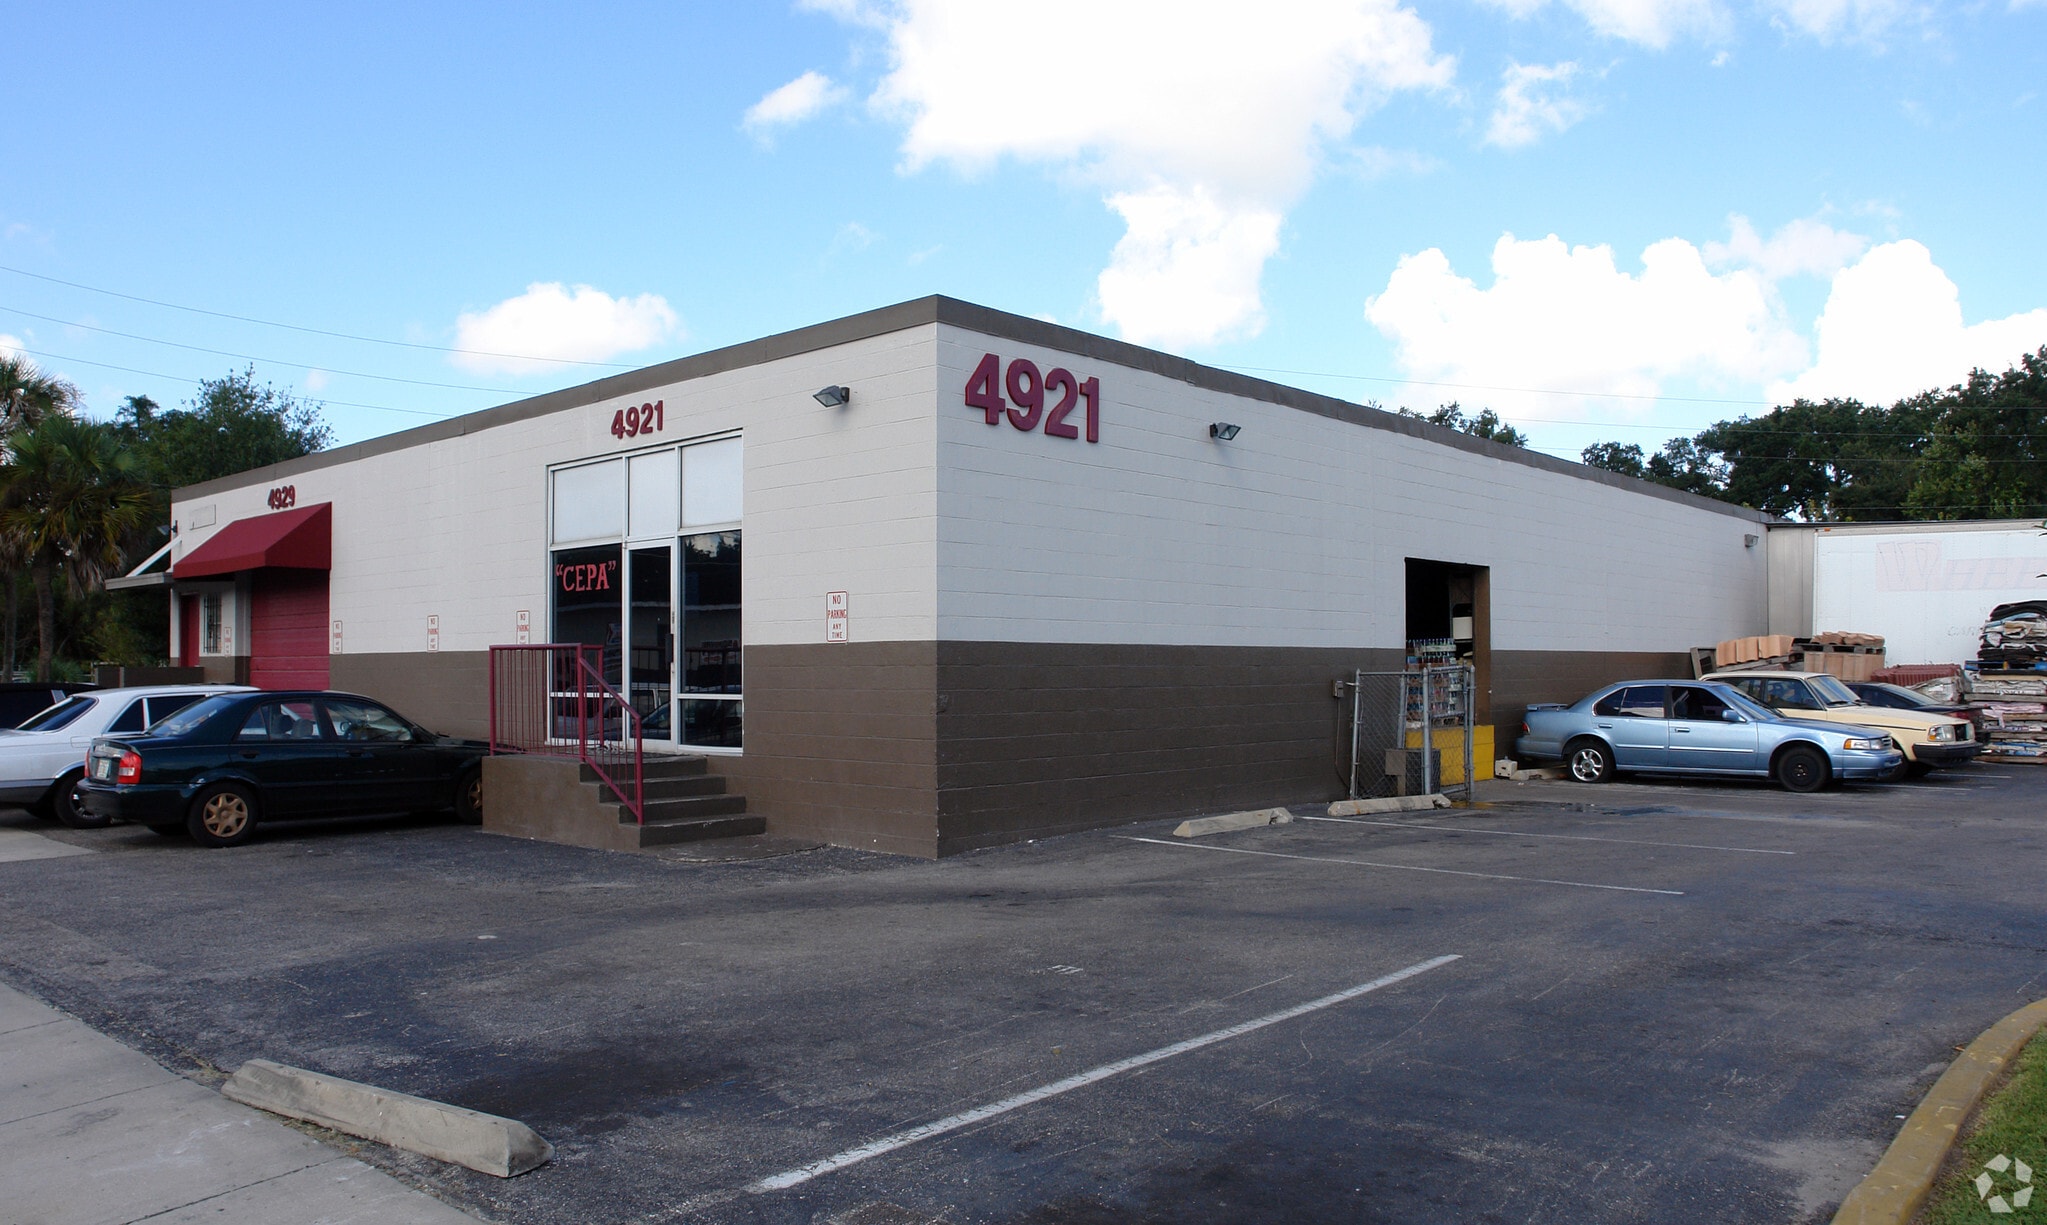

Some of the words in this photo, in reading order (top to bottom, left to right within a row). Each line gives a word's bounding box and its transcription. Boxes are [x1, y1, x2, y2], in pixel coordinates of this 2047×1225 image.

[965, 353, 1099, 443] 4921
[611, 400, 663, 439] 4921
[267, 485, 296, 510] 4929
[832, 595, 842, 604] NO
[827, 609, 847, 619] PARKING
